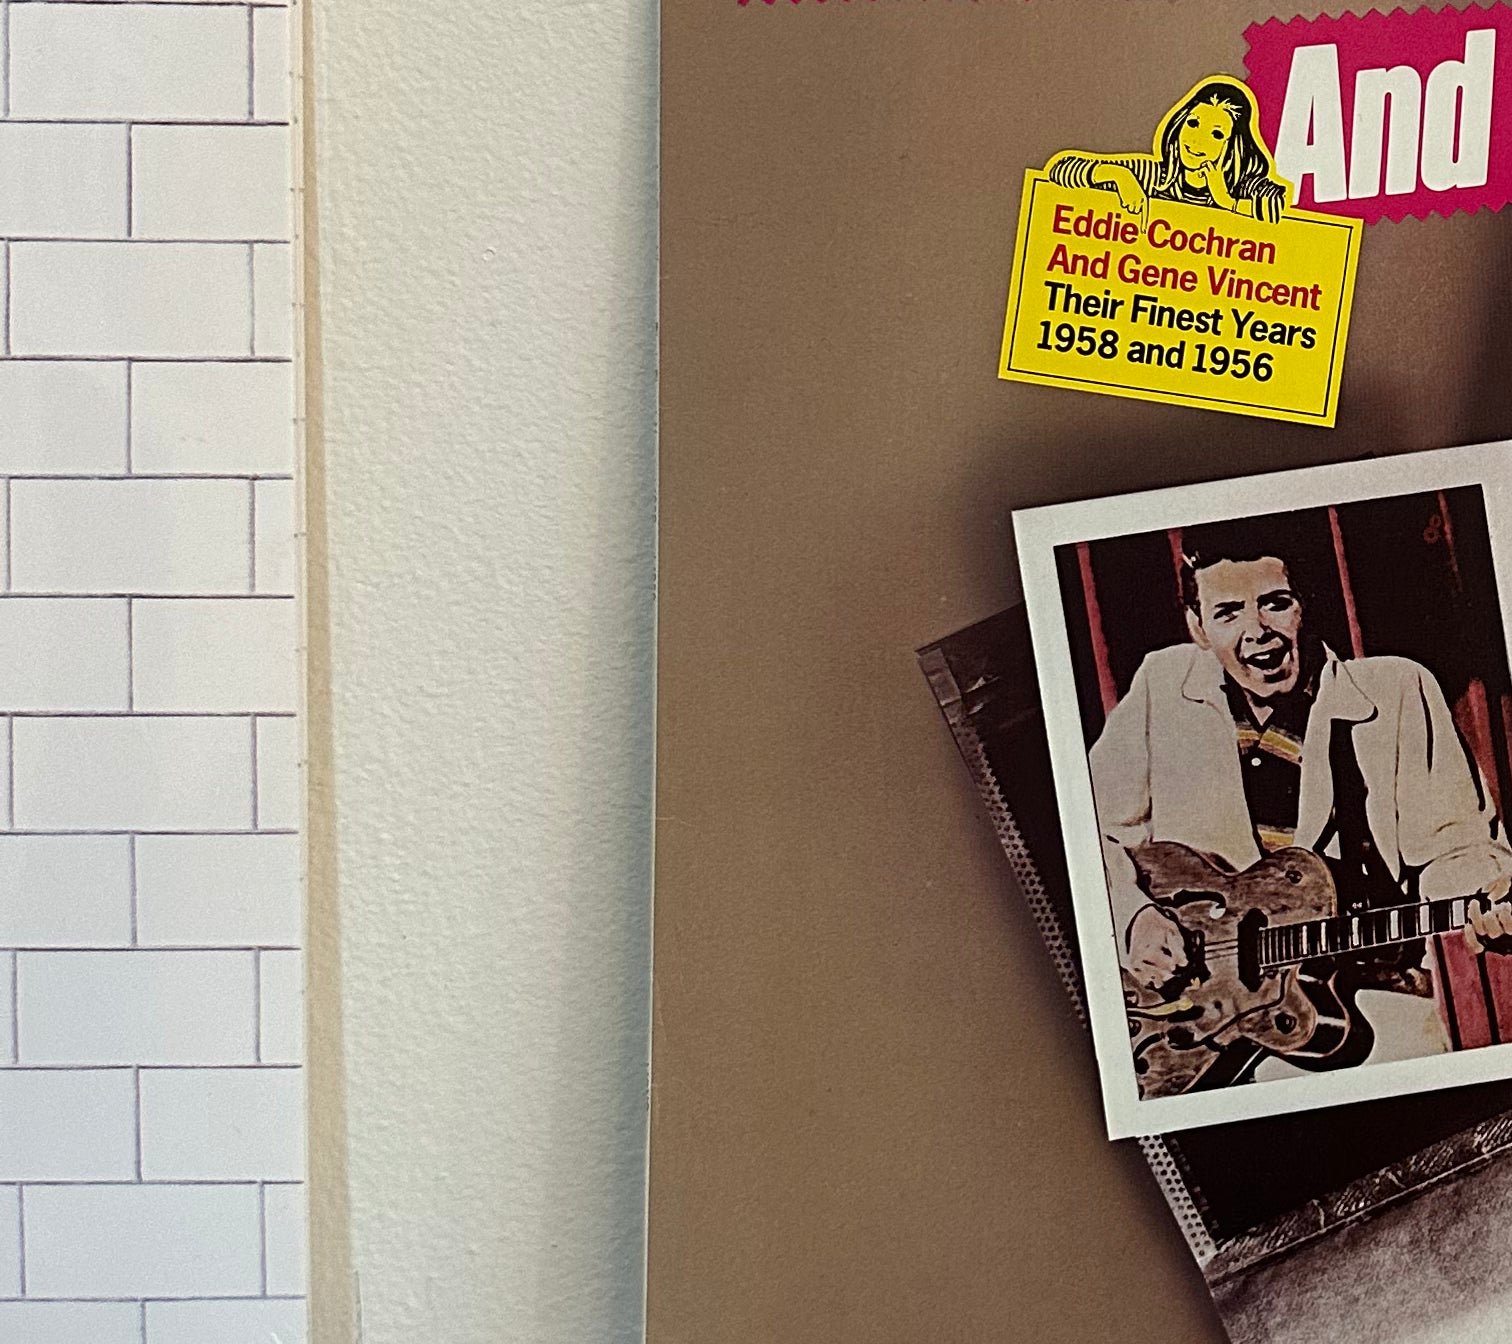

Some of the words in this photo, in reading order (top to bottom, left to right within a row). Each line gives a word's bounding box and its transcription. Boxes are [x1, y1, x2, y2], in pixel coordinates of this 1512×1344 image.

[1274, 31, 1497, 206] And
[1051, 203, 1139, 245] Eddie
[1147, 218, 1276, 265] Cochran
[1046, 243, 1109, 280] And
[1117, 255, 1198, 293] Gene
[1207, 266, 1322, 311] Vincent
[1043, 281, 1125, 320] Their
[1130, 295, 1224, 336] Finest
[1231, 308, 1317, 349] Years
[1036, 320, 1120, 359] 1958
[1128, 339, 1187, 370] and
[1191, 344, 1274, 382] 1956
